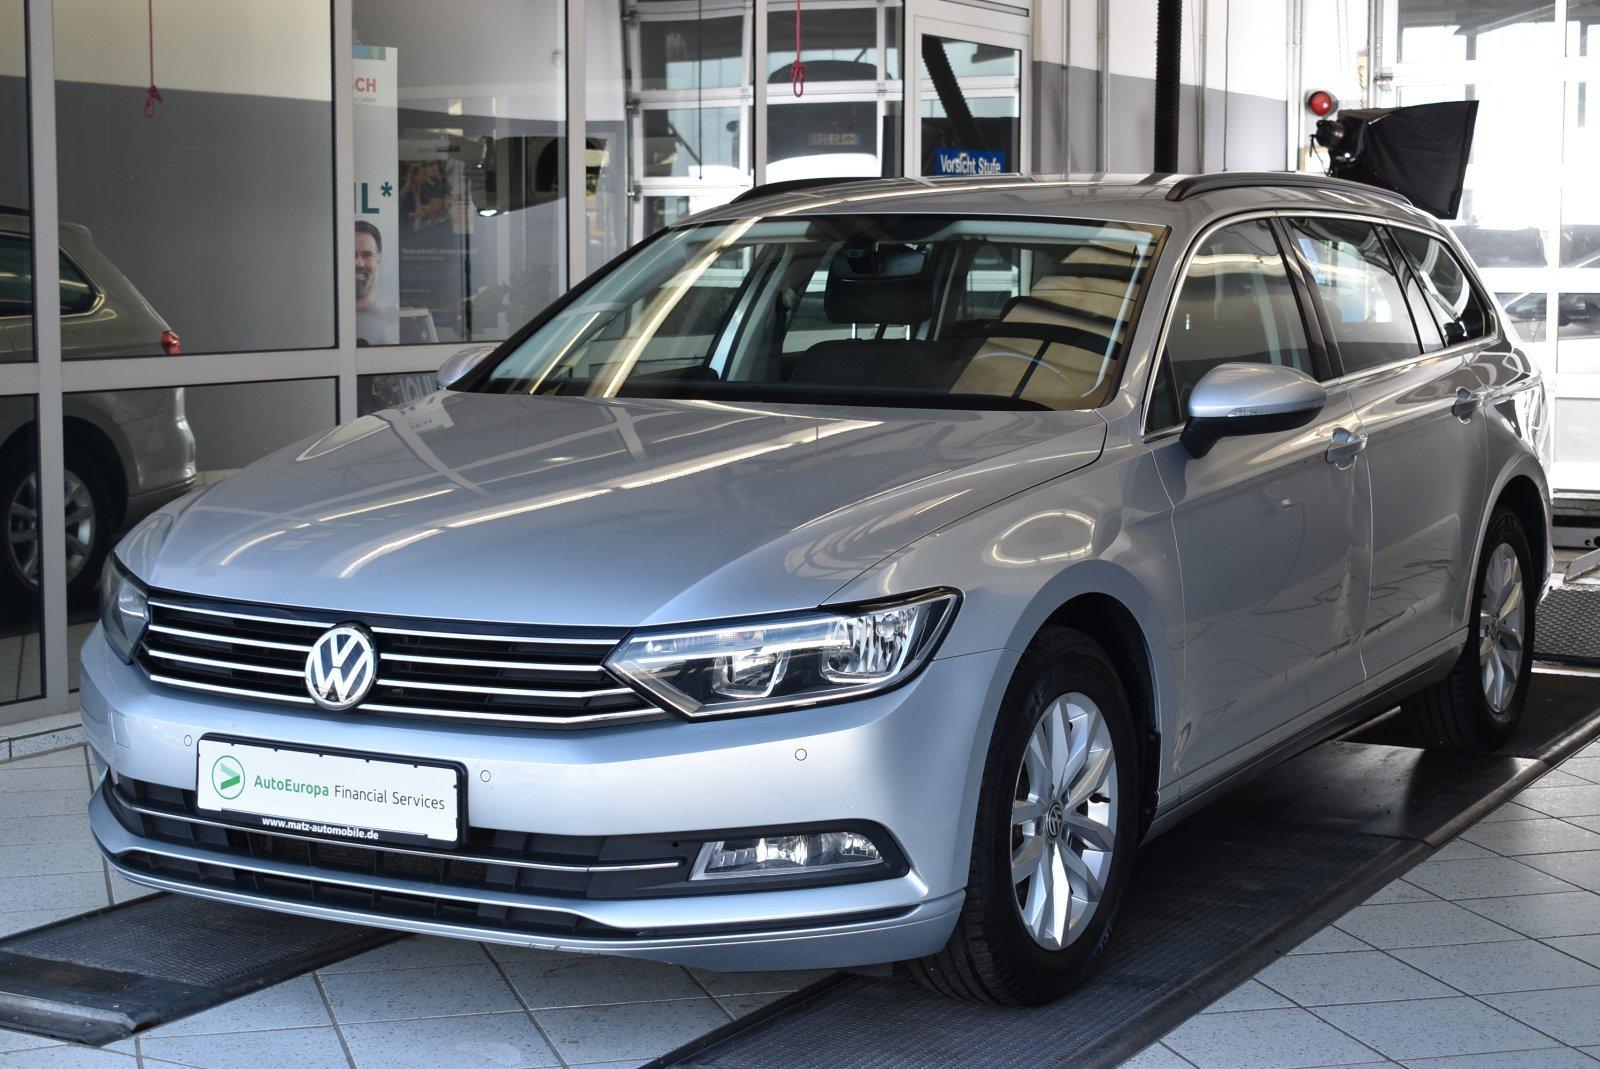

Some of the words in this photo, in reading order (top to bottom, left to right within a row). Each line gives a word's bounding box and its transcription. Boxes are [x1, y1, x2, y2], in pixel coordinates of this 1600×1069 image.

[353, 77, 376, 93] CH
[940, 154, 976, 174] Vorsicht
[978, 157, 1001, 174] Stufe
[254, 775, 329, 798] AutoEuropa
[334, 785, 388, 804] Financial
[392, 792, 445, 810] Services
[262, 816, 379, 840] www.matz-automobile.de
